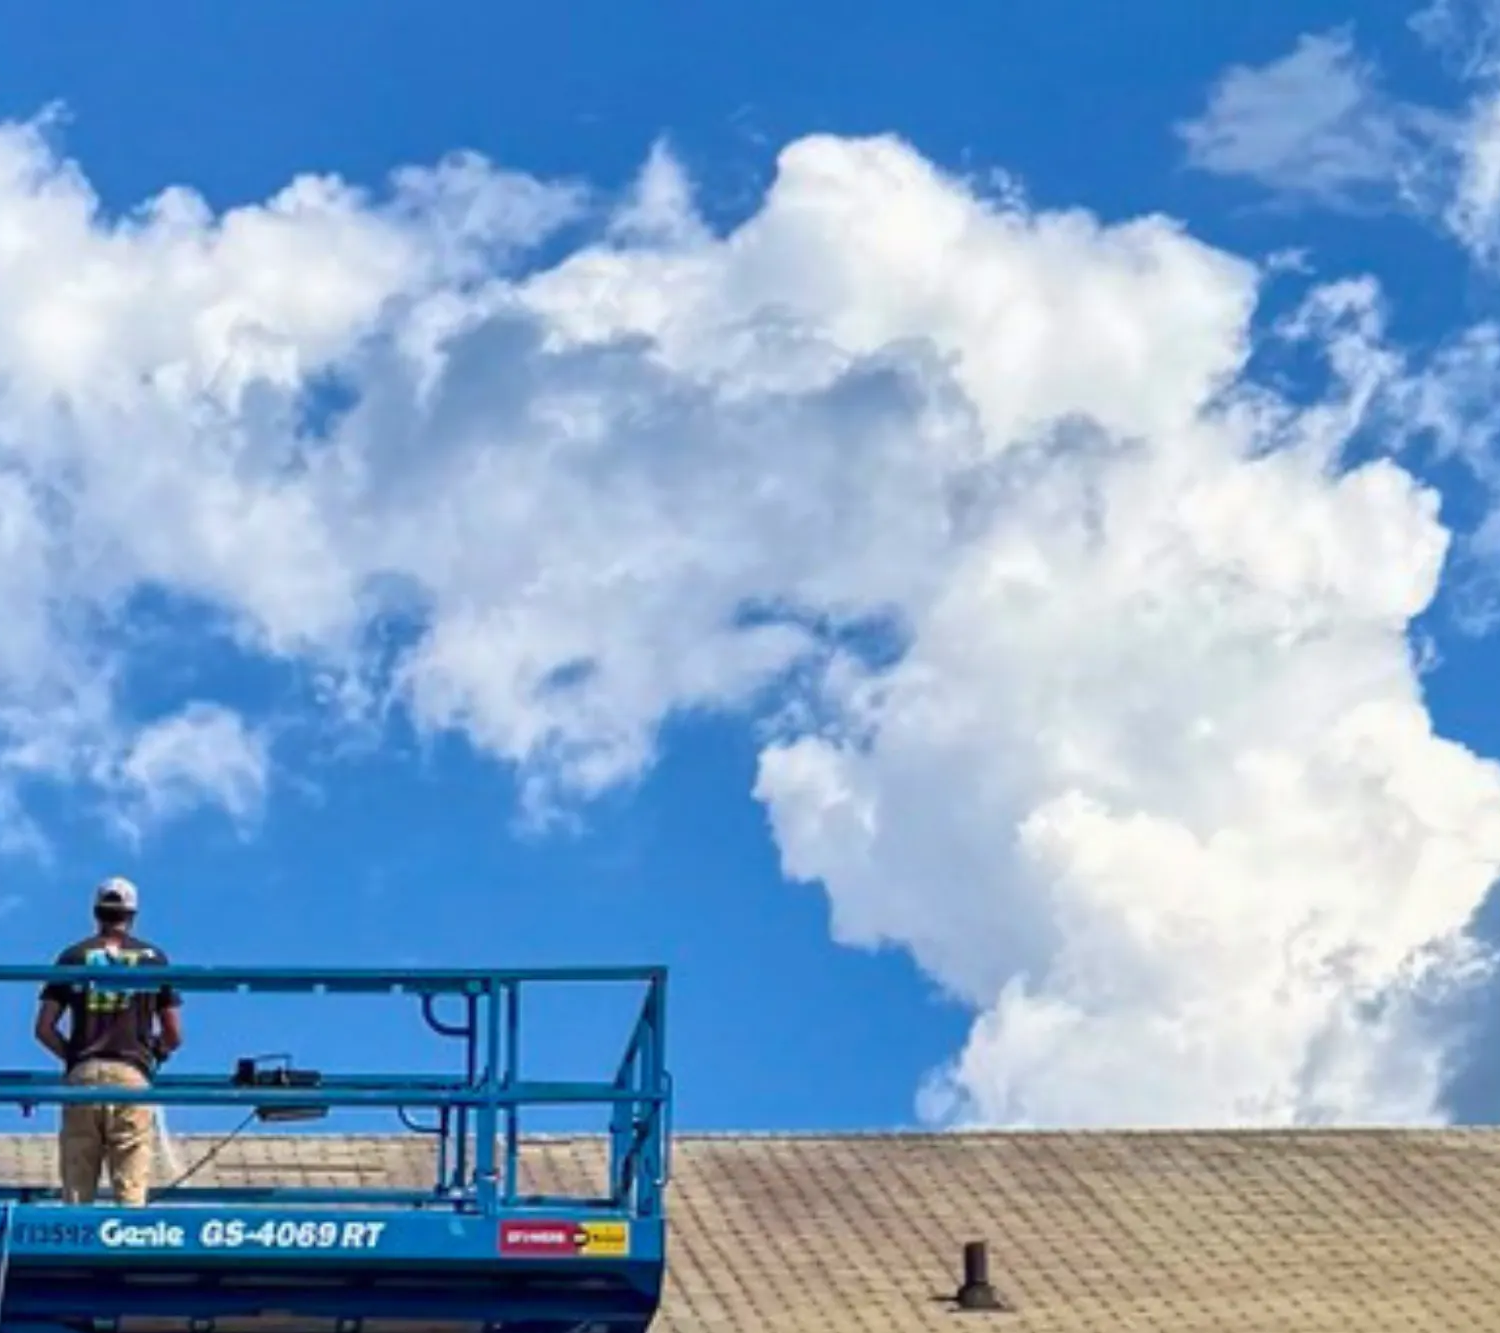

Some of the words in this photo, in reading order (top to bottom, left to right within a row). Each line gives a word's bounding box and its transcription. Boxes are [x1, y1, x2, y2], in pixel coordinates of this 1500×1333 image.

[100, 1219, 184, 1246] Genie
[200, 1219, 337, 1247] GS-4069
[342, 1222, 385, 1247] RT
